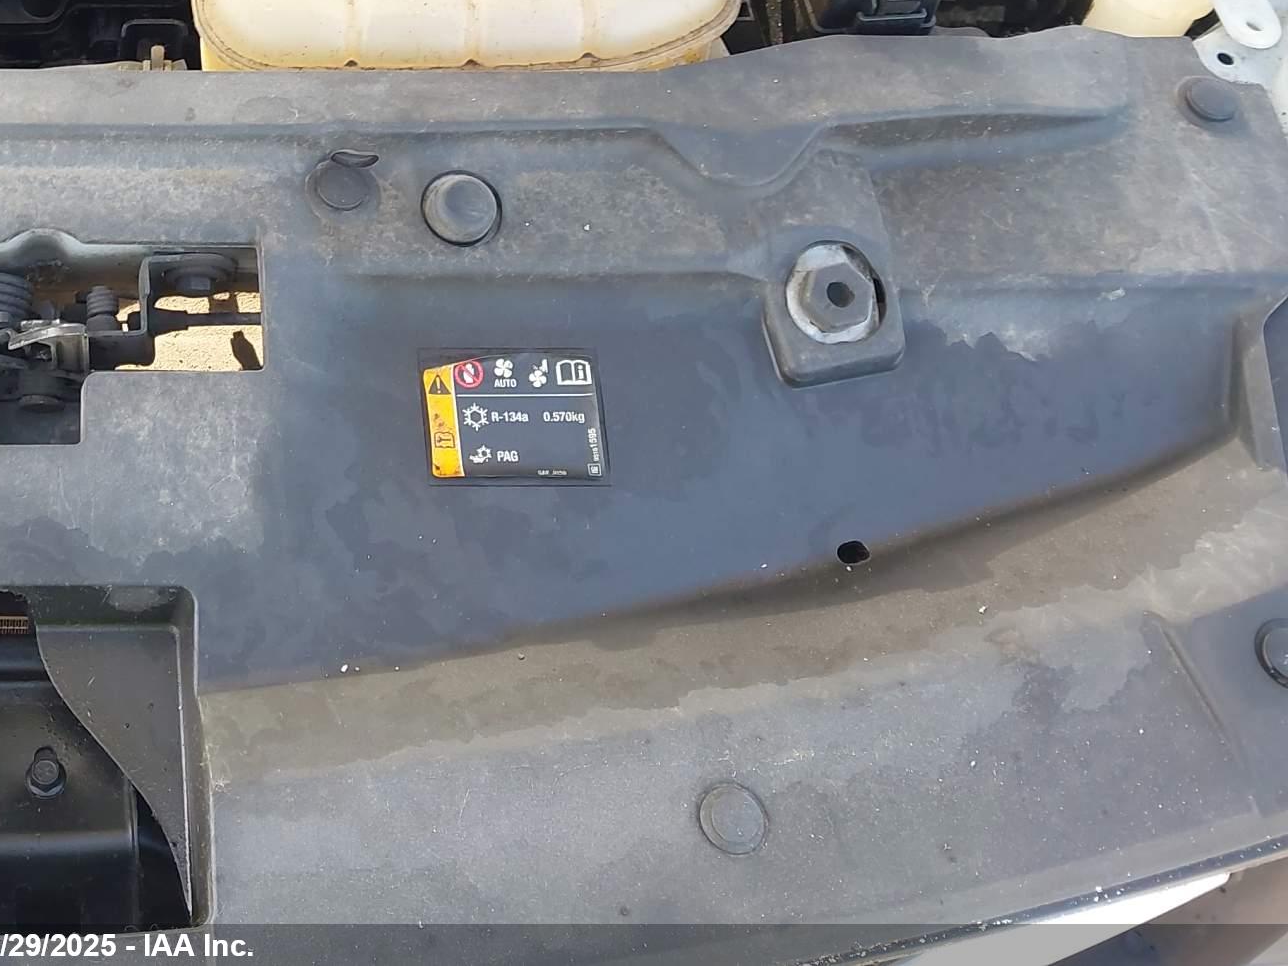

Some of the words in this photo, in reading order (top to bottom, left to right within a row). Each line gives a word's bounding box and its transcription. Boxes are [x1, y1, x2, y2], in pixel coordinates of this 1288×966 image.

[494, 379, 517, 388] AUTO
[491, 411, 529, 422] R-134a
[543, 411, 585, 424] 0.570kg
[497, 450, 519, 462] PAG
